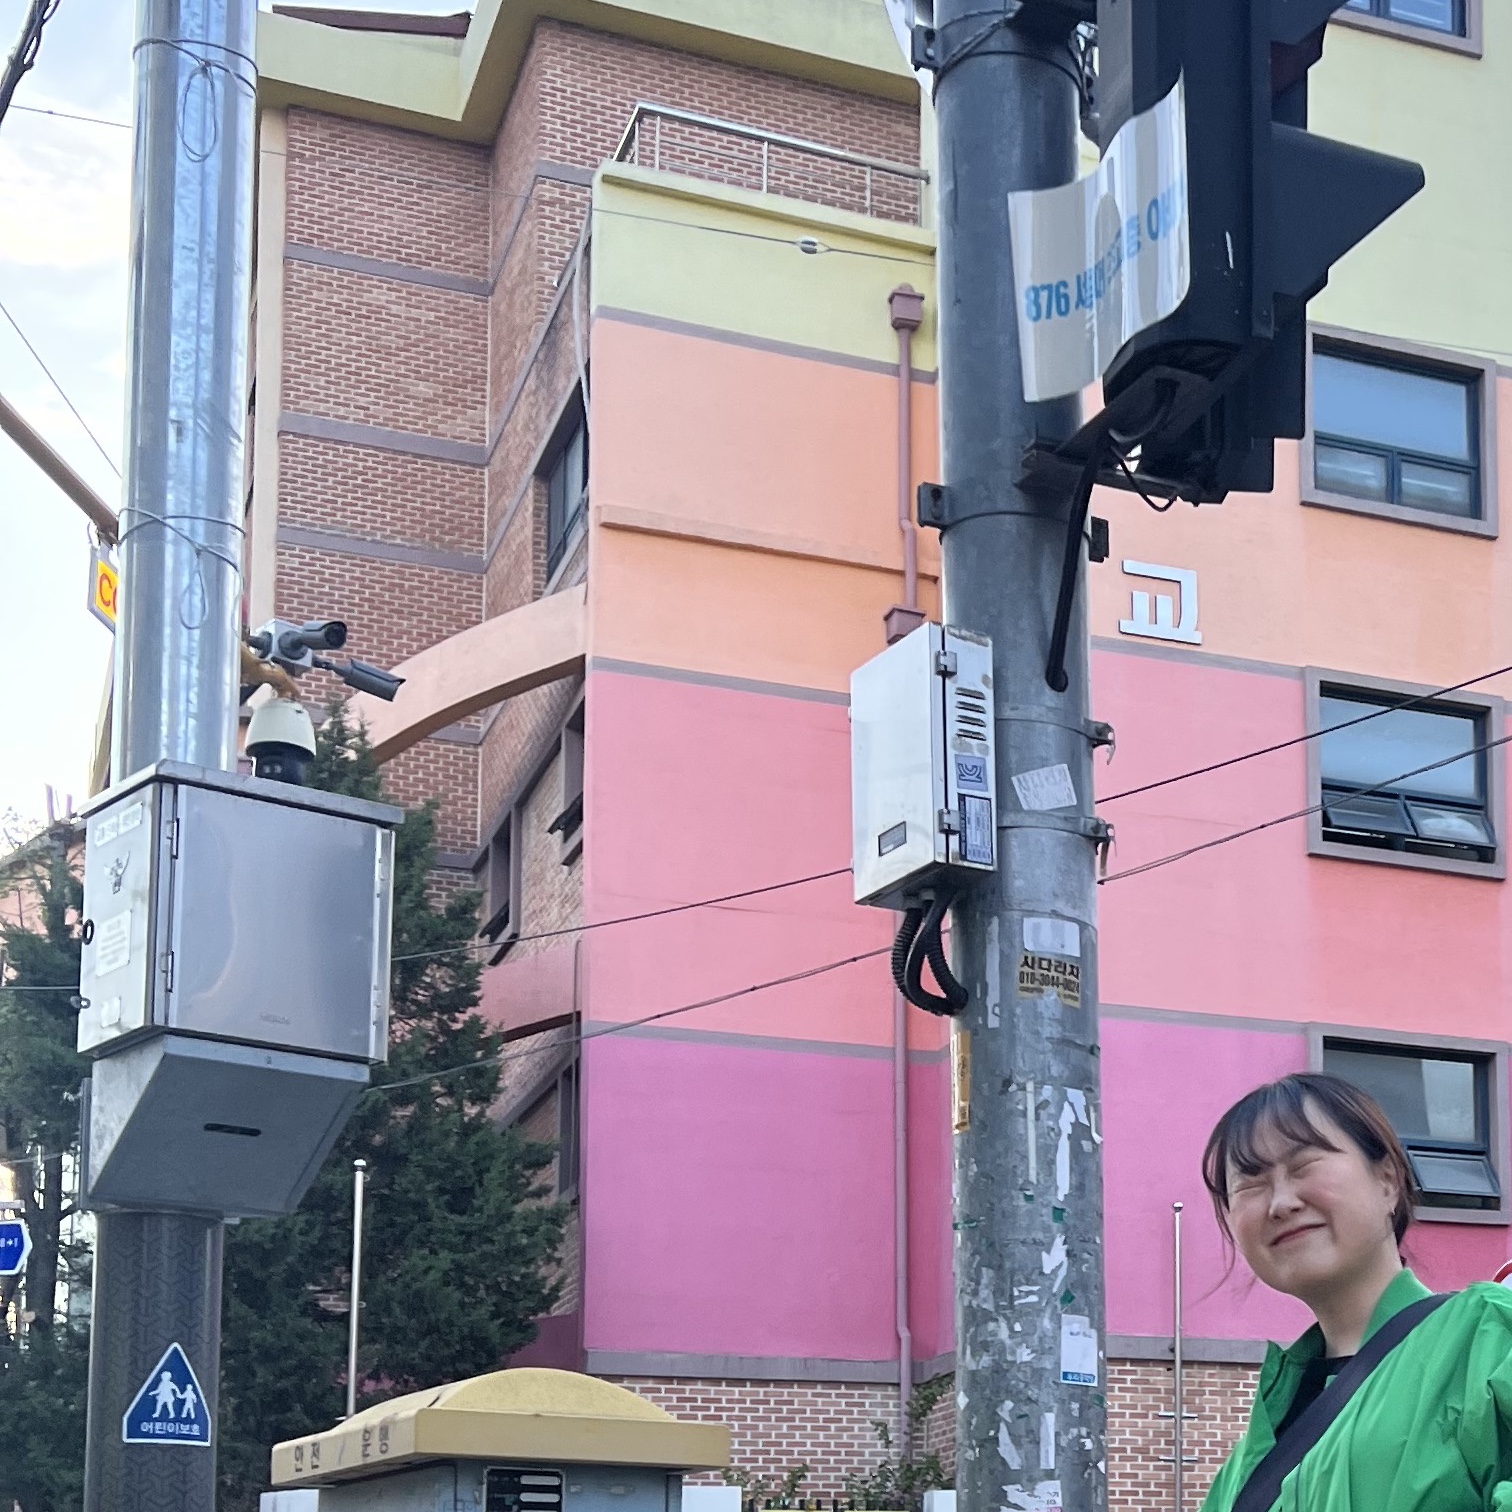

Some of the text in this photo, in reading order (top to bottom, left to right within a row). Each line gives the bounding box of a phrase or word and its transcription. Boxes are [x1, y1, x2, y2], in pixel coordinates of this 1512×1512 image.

[1025, 280, 1071, 323] 876
[1118, 559, 1202, 646] 교
[140, 1421, 200, 1436] 어린이보호
